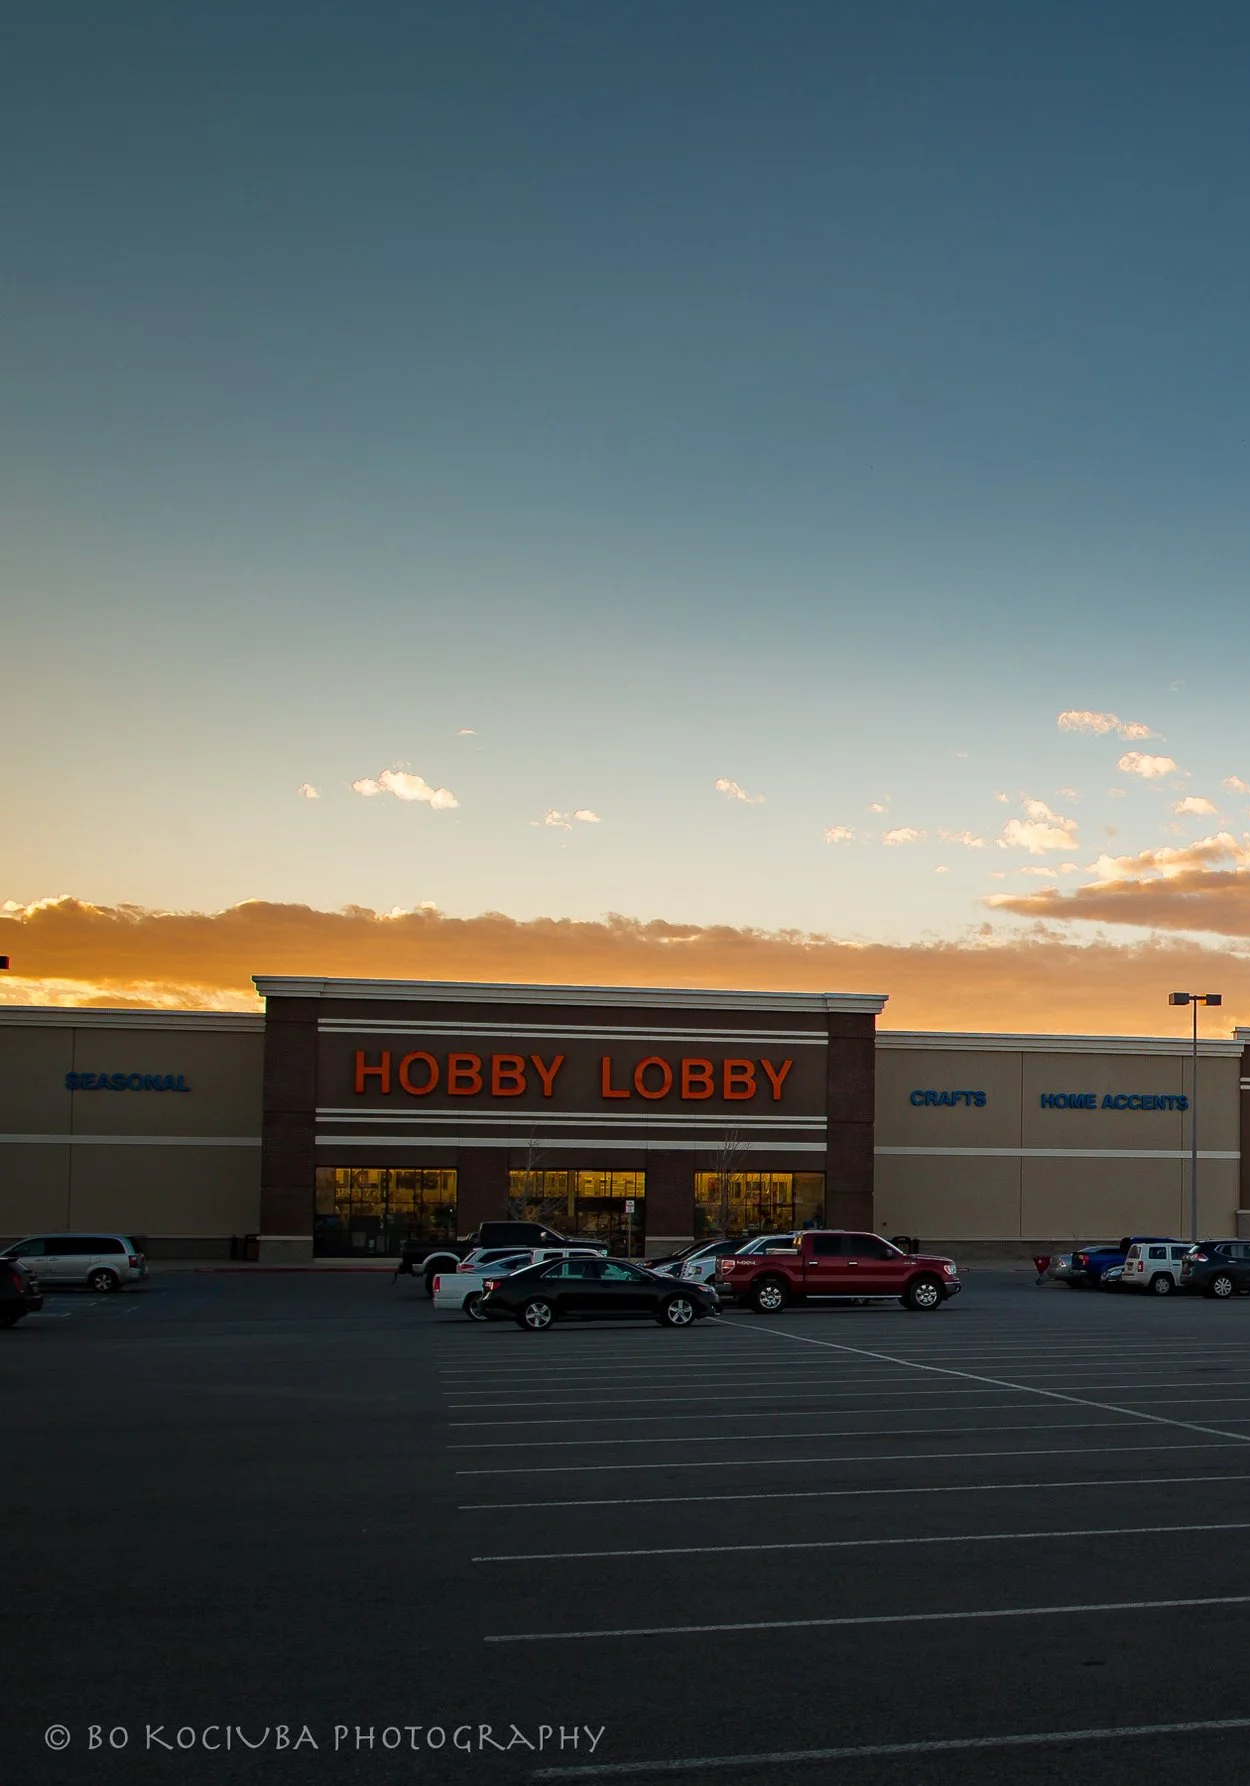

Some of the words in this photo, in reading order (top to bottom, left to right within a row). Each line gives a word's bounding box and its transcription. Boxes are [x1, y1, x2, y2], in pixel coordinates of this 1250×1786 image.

[65, 1071, 191, 1092] SEASONAL
[354, 1050, 564, 1097] HOBBY
[601, 1055, 794, 1101] LOBBY
[910, 1089, 987, 1107] CRAFTS
[1040, 1092, 1098, 1110] HOME
[1101, 1093, 1190, 1113] ACCENTS
